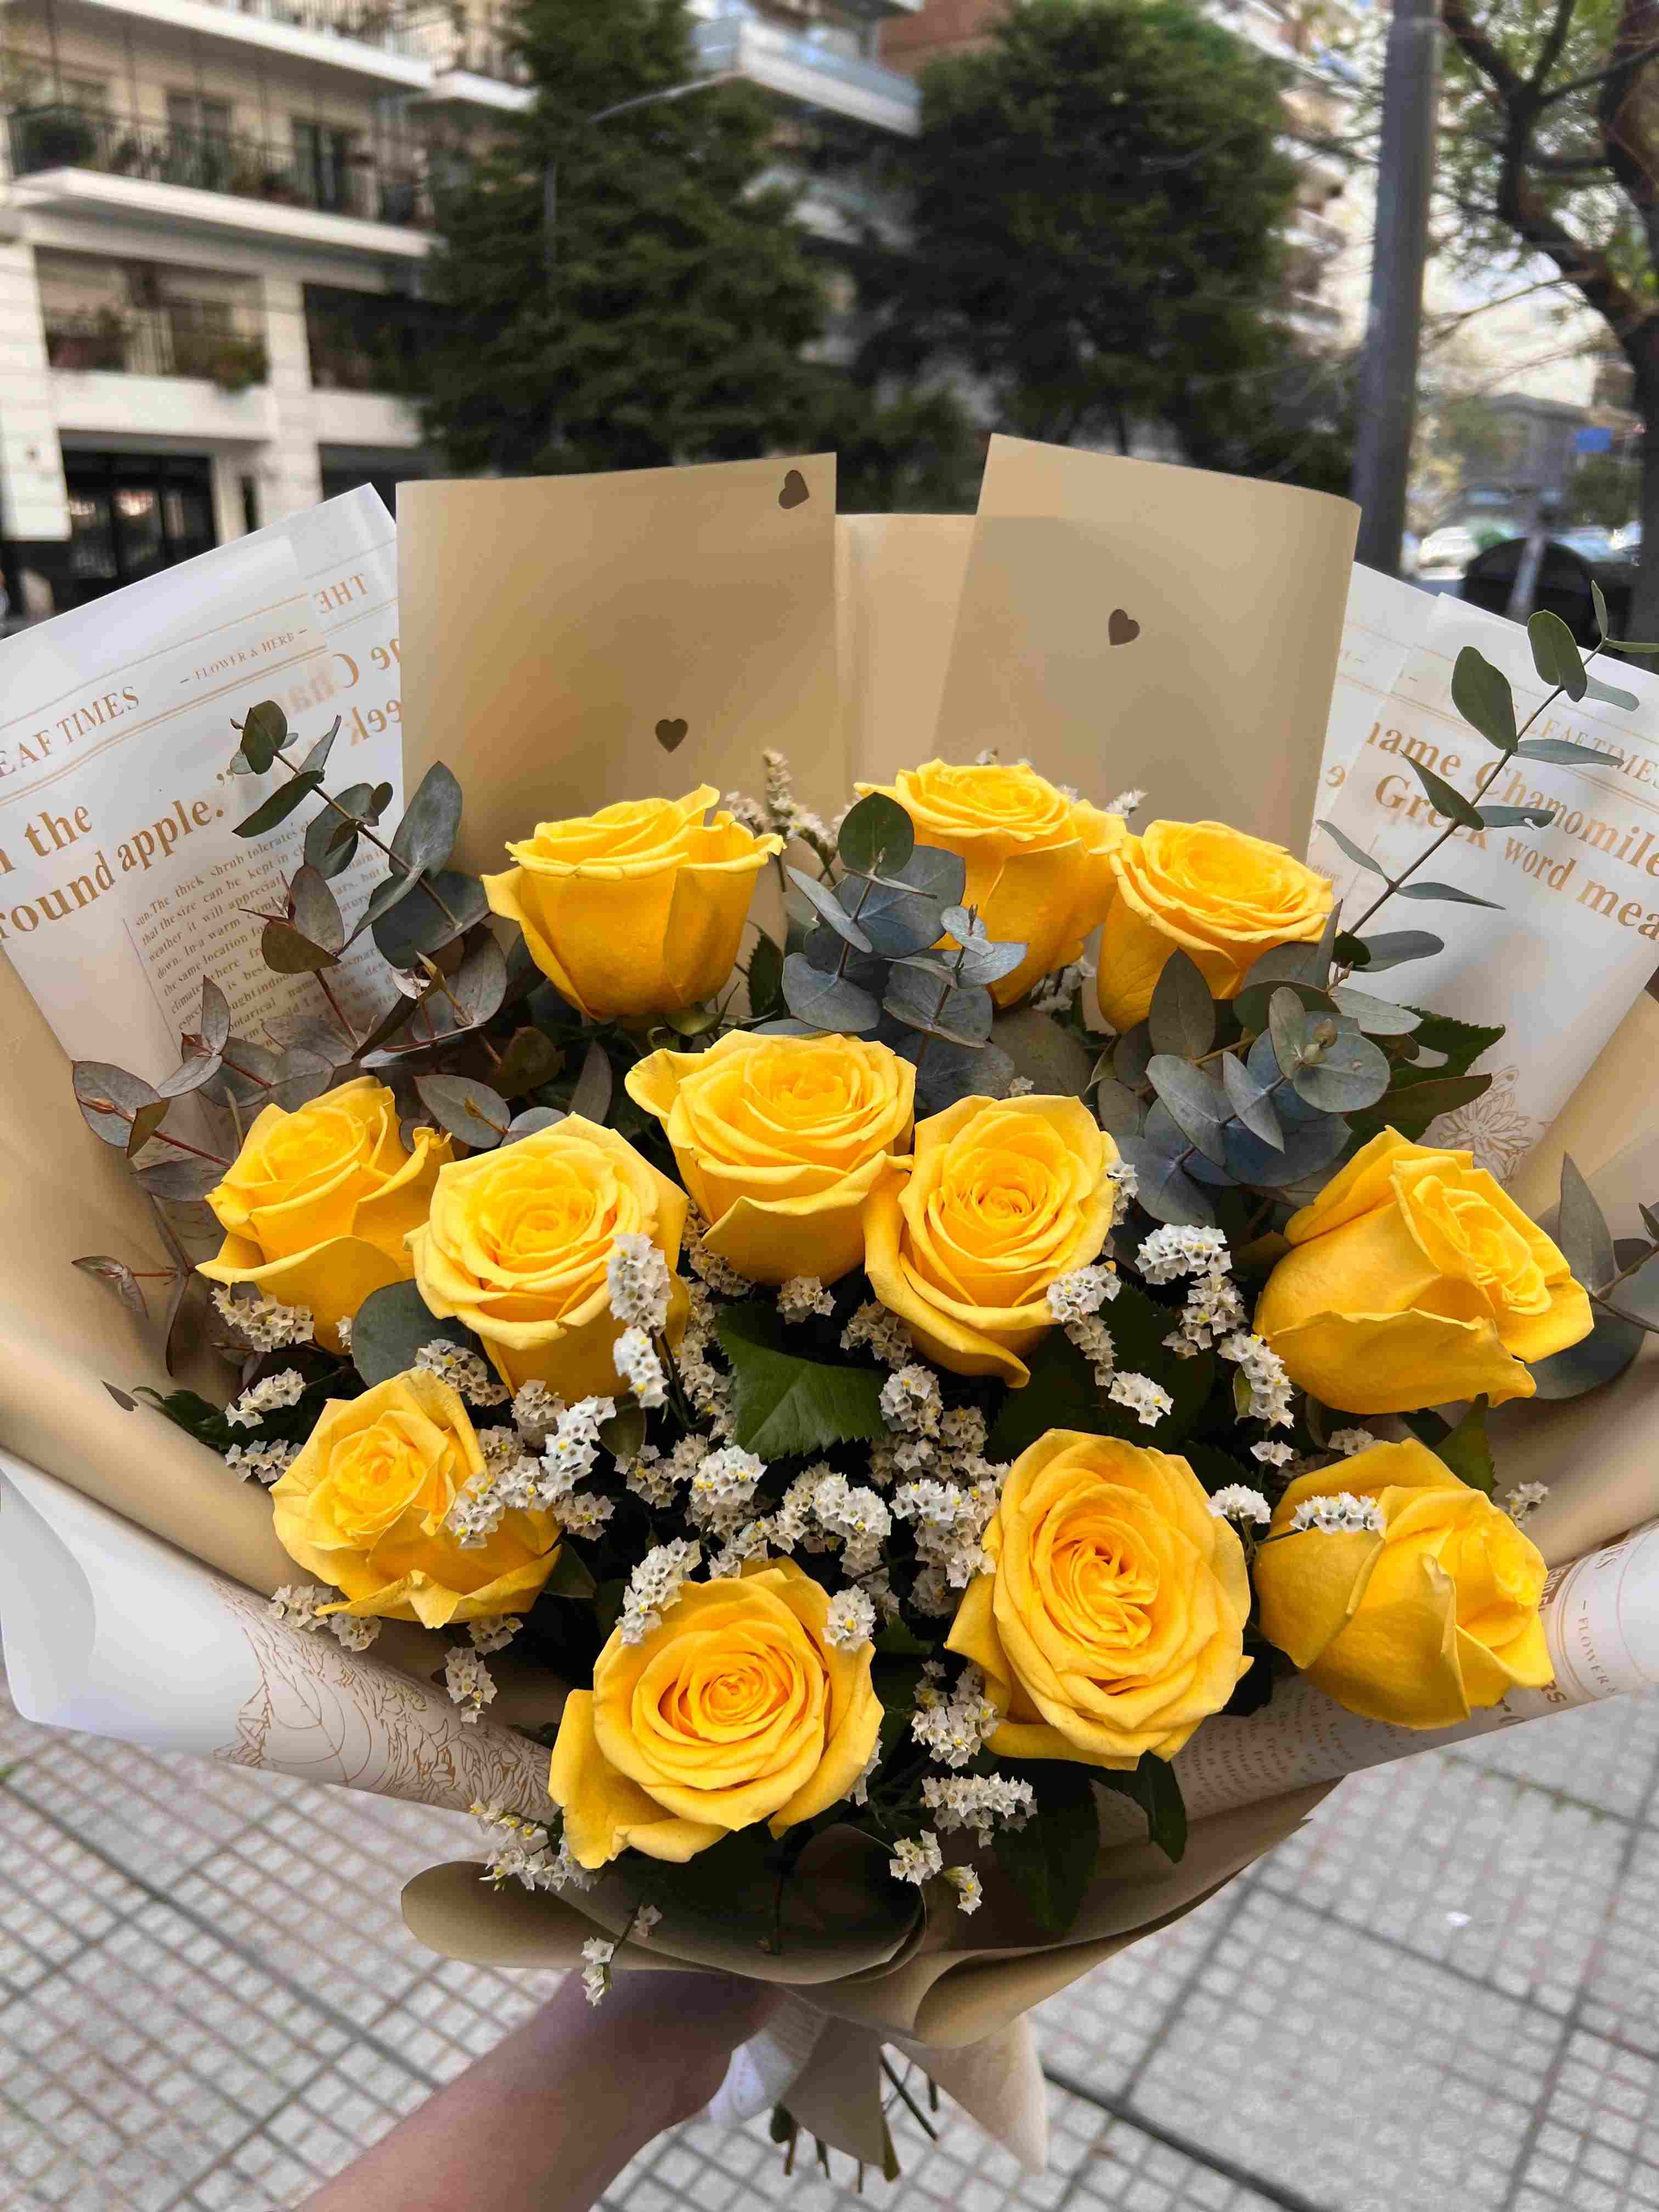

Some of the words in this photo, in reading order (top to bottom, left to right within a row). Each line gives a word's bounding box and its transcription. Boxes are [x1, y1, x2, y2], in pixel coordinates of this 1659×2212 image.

[195, 652, 247, 681] FLOWER
[56, 685, 139, 745] TIMES
[25, 806, 92, 857] the
[150, 897, 170, 913] The
[175, 876, 205, 898] thick
[247, 832, 298, 859] tolerates
[1504, 836, 1576, 891] word
[160, 915, 176, 930] the
[202, 886, 224, 904] can
[247, 861, 274, 879] kept
[149, 931, 183, 962] weather
[202, 904, 224, 923] will
[202, 934, 249, 965] location
[207, 918, 241, 940] warm
